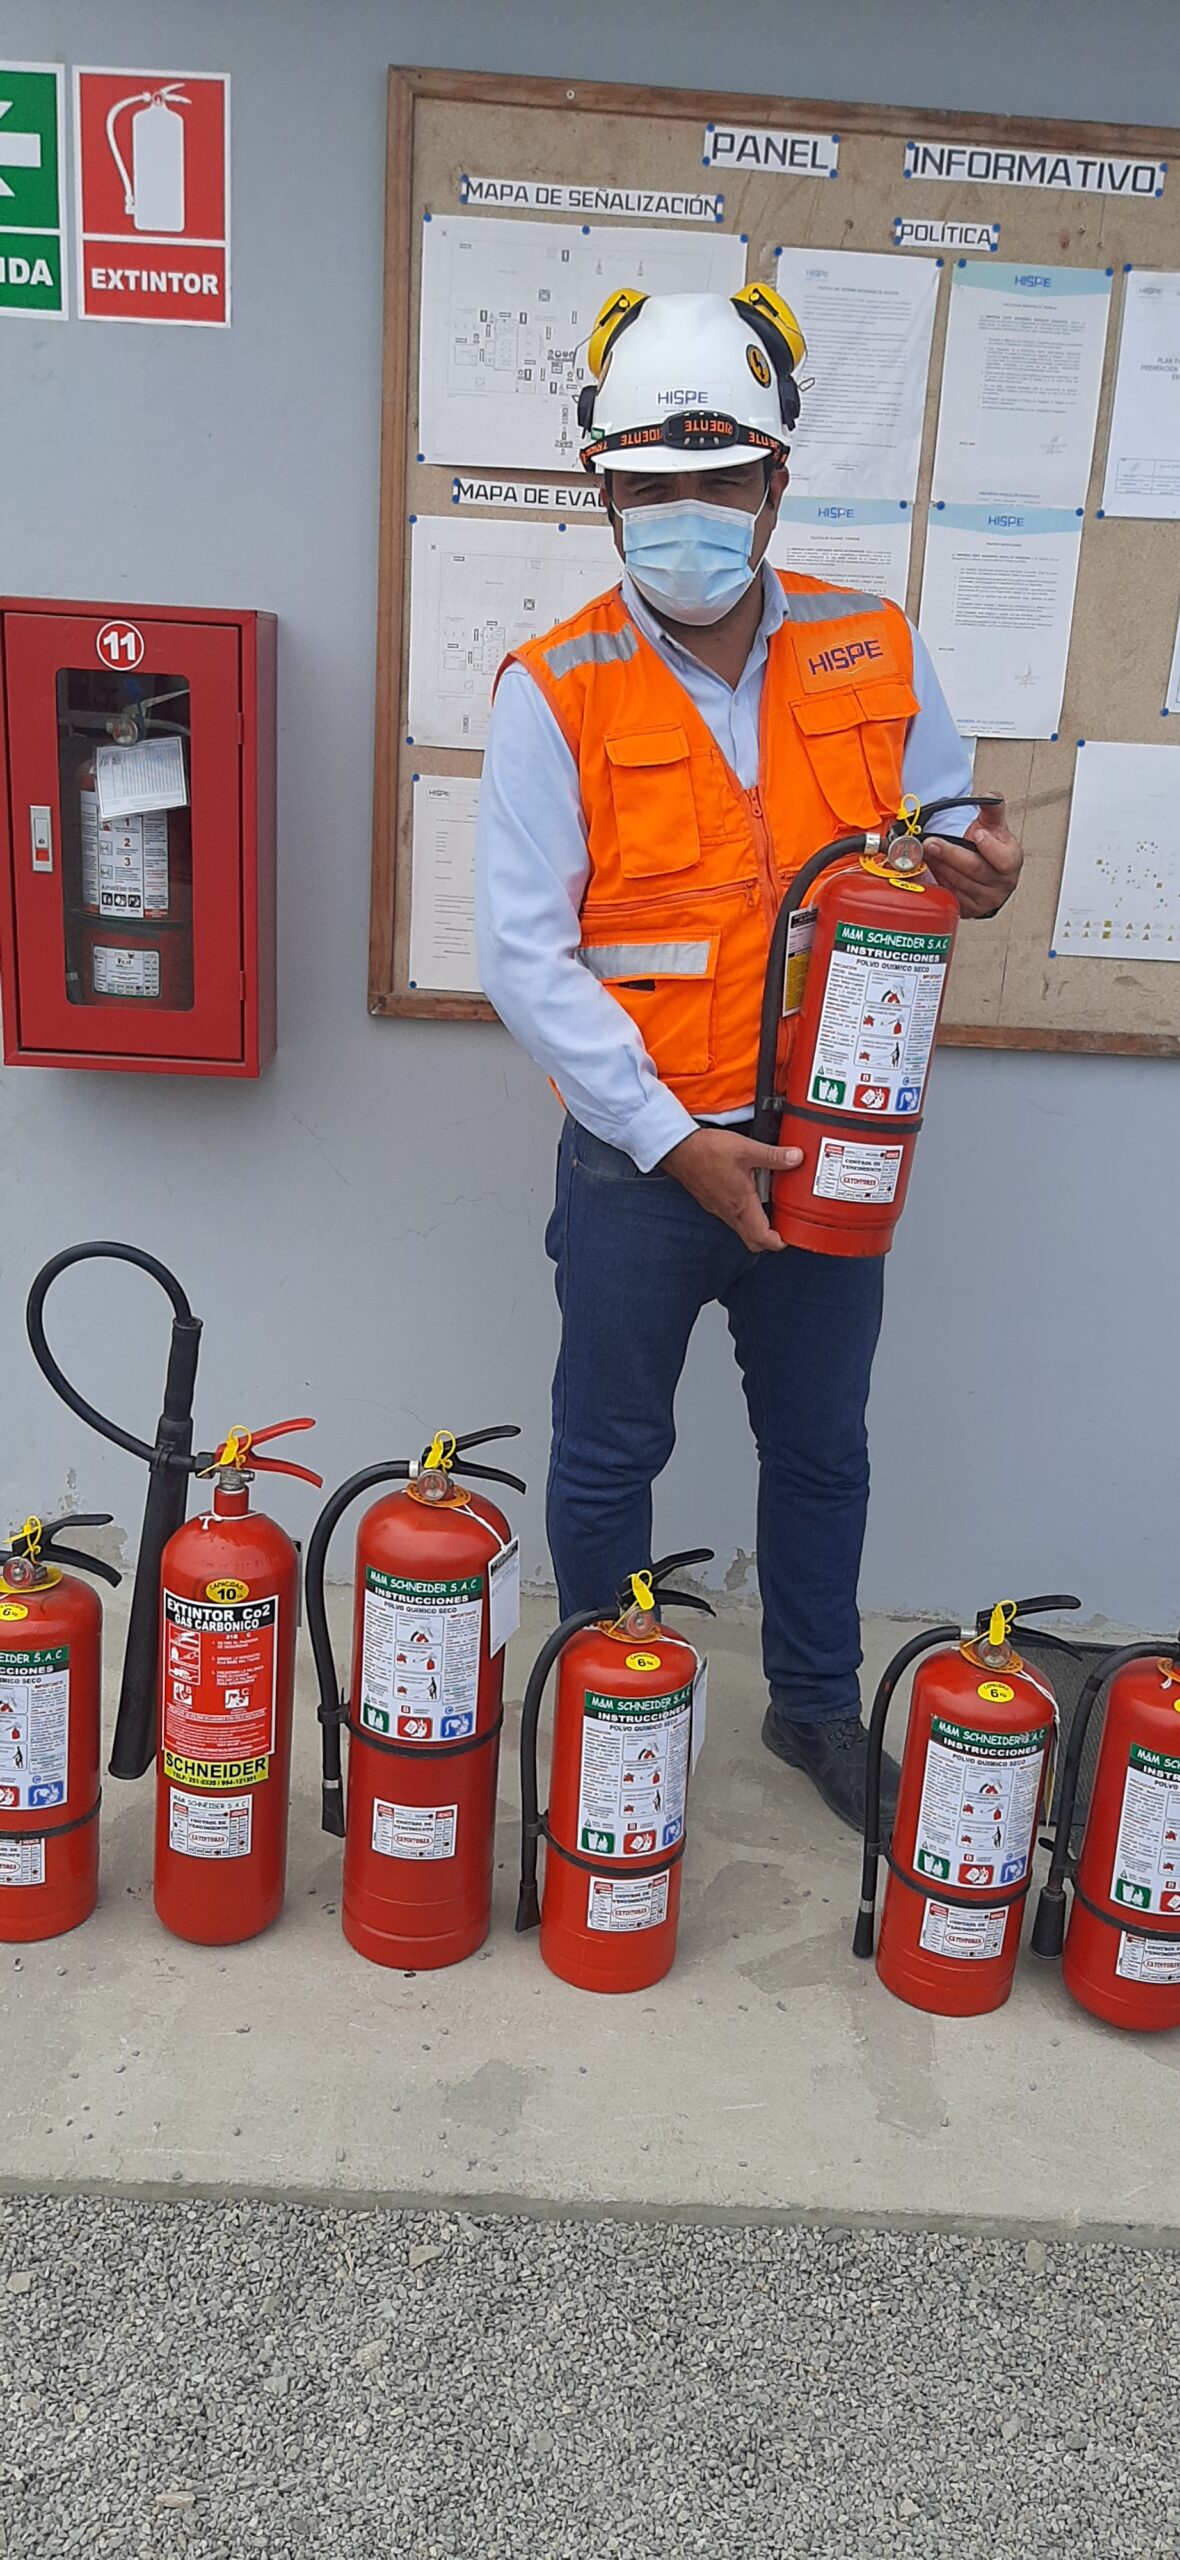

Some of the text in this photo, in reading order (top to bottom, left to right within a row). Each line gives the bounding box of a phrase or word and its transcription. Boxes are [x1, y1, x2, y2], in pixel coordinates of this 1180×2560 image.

[712, 132, 1156, 193] PANEL INFORMATIVO
[466, 181, 718, 216] MAPA DE SEÑALIZACIÓN
[901, 221, 992, 245] POLÍTICA
[91, 268, 218, 295] EXTINTOR
[1014, 275, 1051, 288] HISPE
[658, 390, 709, 405] HISPE
[457, 483, 518, 502] MAPA
[524, 488, 550, 505] DE
[818, 507, 854, 519] HISPE
[988, 515, 1024, 527] HISPE
[104, 631, 136, 660] 11
[808, 639, 883, 676] HISPE
[124, 838, 131, 848] 2
[124, 857, 131, 867] 3
[842, 927, 863, 941] M&M
[867, 932, 924, 949] SCHNEIDER
[847, 944, 939, 963] INSTRUCCIONES
[856, 959, 879, 969] POLVO
[218, 1589, 236, 1600] 10
[390, 1580, 447, 1593] SCHNEIDER
[450, 1579, 477, 1592] S.A.C
[375, 1586, 469, 1605] INSTRUCCIONES
[167, 1598, 270, 1621] EXTINTOR Co2
[384, 1601, 405, 1612] POLVO
[175, 1615, 259, 1632] GAS CARBONICO
[33, 1650, 63, 1662] S.A.C
[991, 1689, 999, 1698] 6
[591, 1697, 614, 1709] M&M
[617, 1697, 672, 1711] SCHNEIDER
[598, 1704, 686, 1723] INSTRUCCIONES
[609, 1724, 632, 1732] POLVO
[938, 1722, 960, 1737] M&M
[963, 1730, 1019, 1746] SCHNEIDER
[944, 1738, 1037, 1757] INSTRUCCIONES
[166, 1751, 266, 1779] SCHNEIDER
[952, 1753, 976, 1764] POLVO
[1137, 1748, 1160, 1765] M&M
[1154, 1780, 1178, 1790] POLVO
